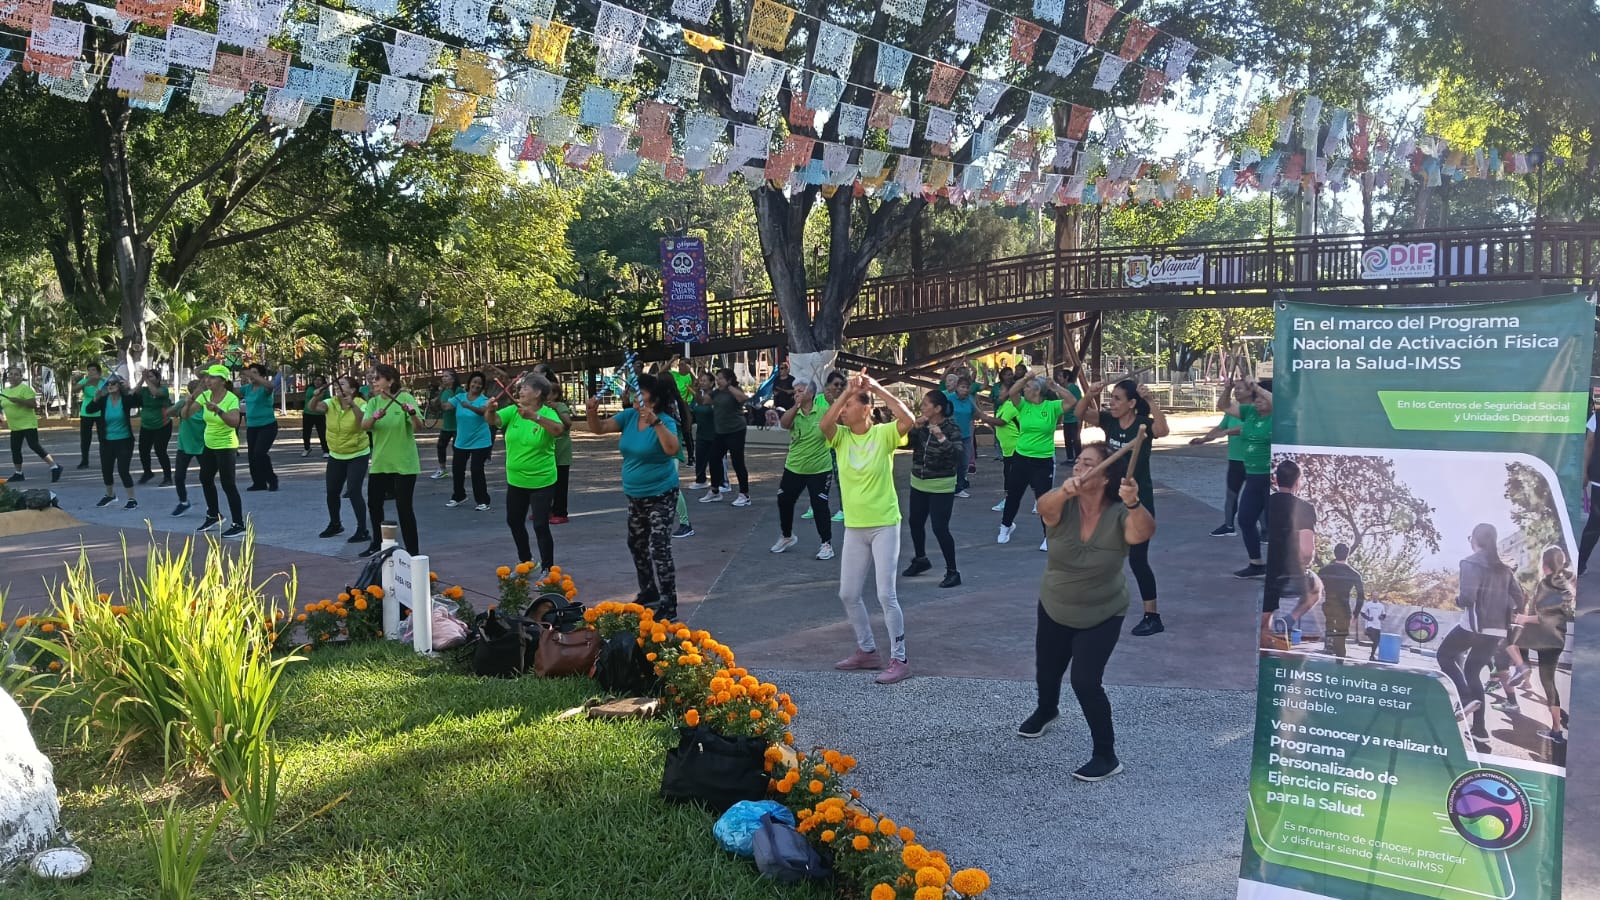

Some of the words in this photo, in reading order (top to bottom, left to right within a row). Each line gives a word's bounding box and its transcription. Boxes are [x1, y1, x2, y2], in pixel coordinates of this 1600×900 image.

[1152, 256, 1201, 277] Nayarit
[1391, 245, 1433, 265] DIF
[1293, 318, 1315, 331] En
[1320, 316, 1334, 330] el
[1338, 319, 1394, 330] marco
[1397, 316, 1424, 330] del
[1429, 316, 1520, 332] Programa
[1293, 336, 1364, 350] Nacional
[1369, 336, 1392, 350] de
[1397, 335, 1498, 350] Activación
[1504, 334, 1559, 349] Física
[1292, 359, 1330, 372] para
[1336, 356, 1351, 370] la
[1356, 356, 1462, 370] Salud-IMSS
[1397, 400, 1410, 408] En
[1412, 400, 1426, 409] los
[1428, 401, 1467, 410] Centros
[1469, 400, 1481, 410] de
[1484, 401, 1536, 412] Seguridad
[1538, 402, 1570, 411] Social
[1454, 414, 1460, 422] y
[1463, 413, 1510, 422] Unidades
[1512, 414, 1570, 423] Deportivas
[1275, 668, 1286, 678] El
[1290, 670, 1322, 682] IMSS
[1326, 675, 1338, 685] te
[1342, 676, 1377, 690] invita
[1380, 684, 1388, 692] a
[1392, 684, 1412, 695] ser
[1272, 698, 1338, 714] saludable.
[1274, 682, 1302, 694] más
[1304, 687, 1343, 700] activo
[1346, 694, 1375, 705] para
[1378, 698, 1412, 710] estar
[1270, 735, 1346, 758] Programa
[1272, 720, 1296, 732] Ven
[1298, 724, 1307, 734] a
[1308, 726, 1360, 742] conocer
[1360, 734, 1370, 746] y
[1372, 736, 1380, 746] a
[1383, 738, 1431, 753] realizar
[1433, 744, 1448, 756] tu
[1269, 753, 1374, 781] Personalizado
[1378, 770, 1399, 786] de
[1268, 771, 1330, 792] Ejercicio
[1333, 781, 1378, 800] Físico
[1266, 790, 1300, 805] para
[1302, 794, 1316, 808] la
[1318, 798, 1365, 817] Salud.
[1282, 836, 1289, 844] y
[1290, 834, 1336, 852] disfrutar
[1337, 844, 1373, 859] siendo
[1375, 853, 1444, 874] #ActivaIMSS
[1284, 820, 1296, 831] Es
[1298, 825, 1350, 842] momento
[1352, 835, 1366, 845] de
[1368, 840, 1414, 855] conocer,
[1416, 848, 1467, 865] practicar
